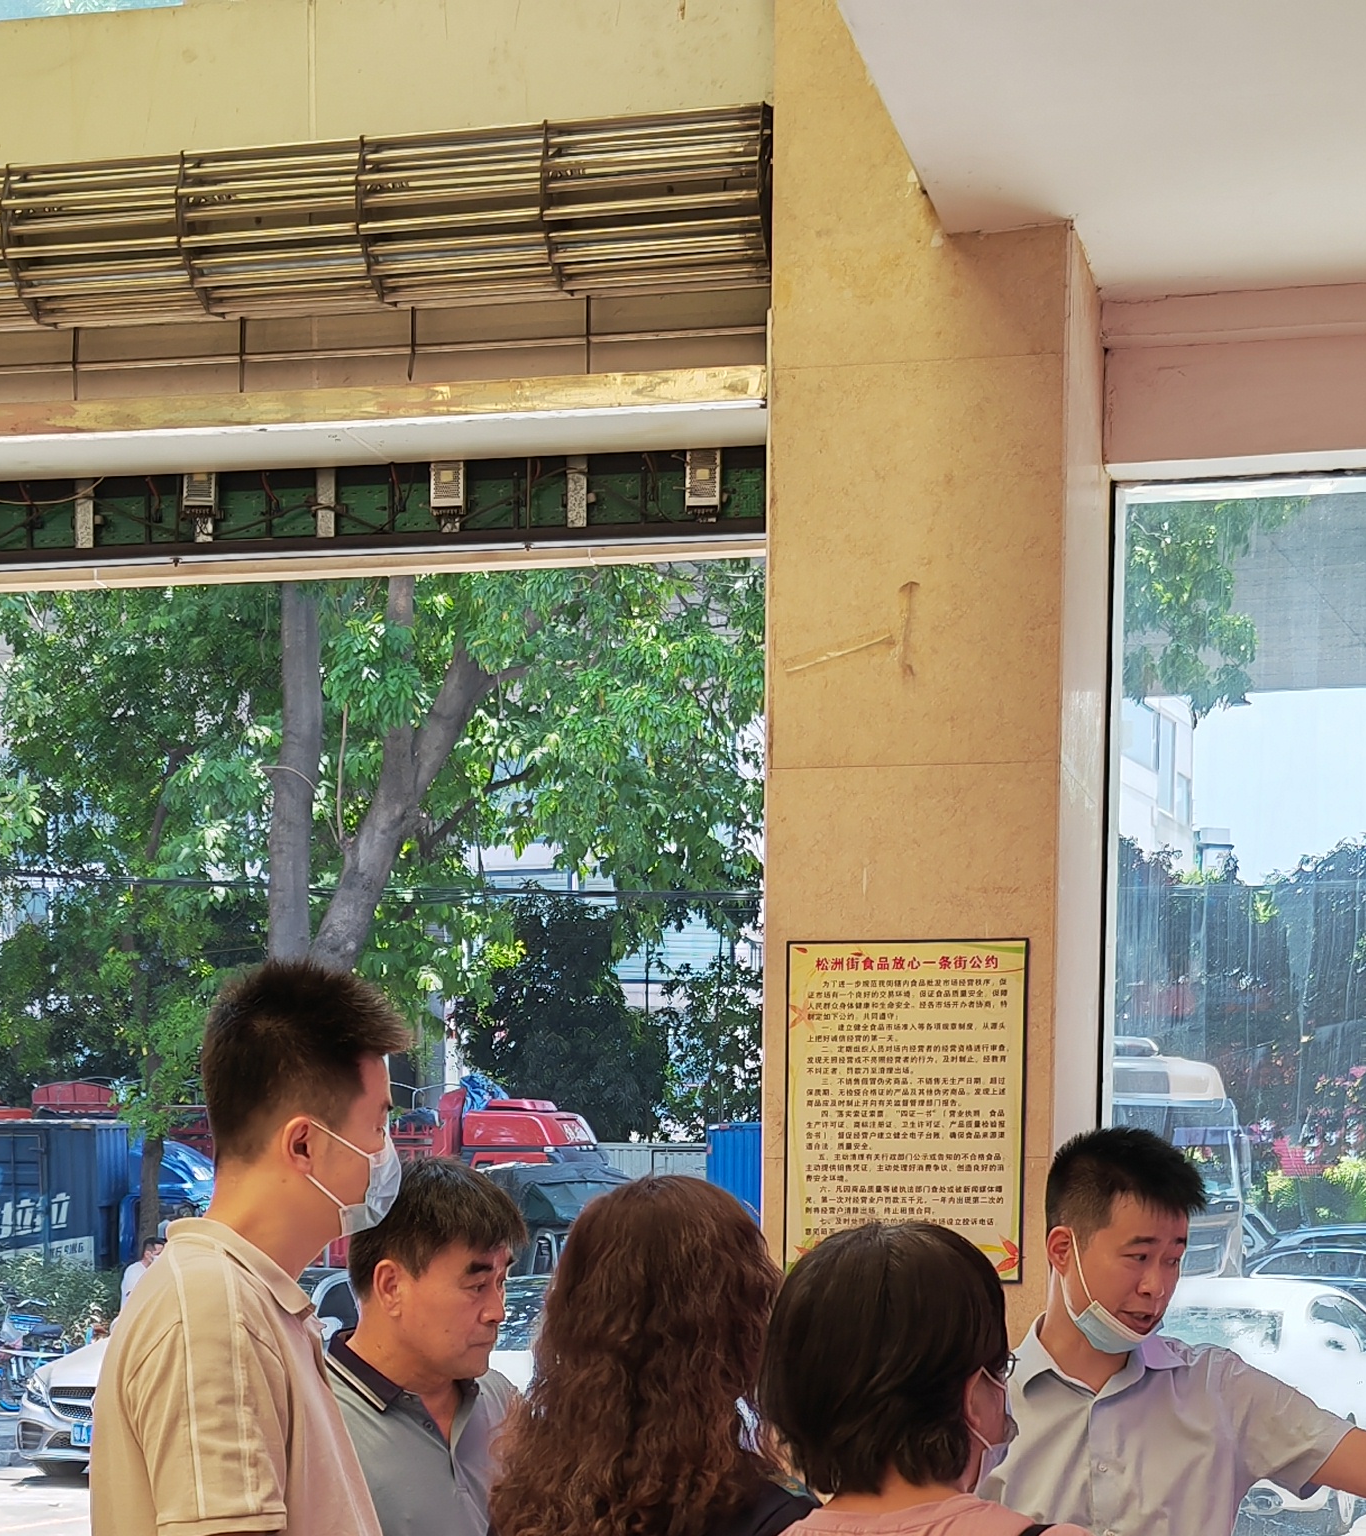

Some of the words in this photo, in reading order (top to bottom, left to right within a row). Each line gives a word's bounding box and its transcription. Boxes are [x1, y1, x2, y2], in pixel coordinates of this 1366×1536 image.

[815, 955, 998, 971] 松洲街食品放心一条街公约
